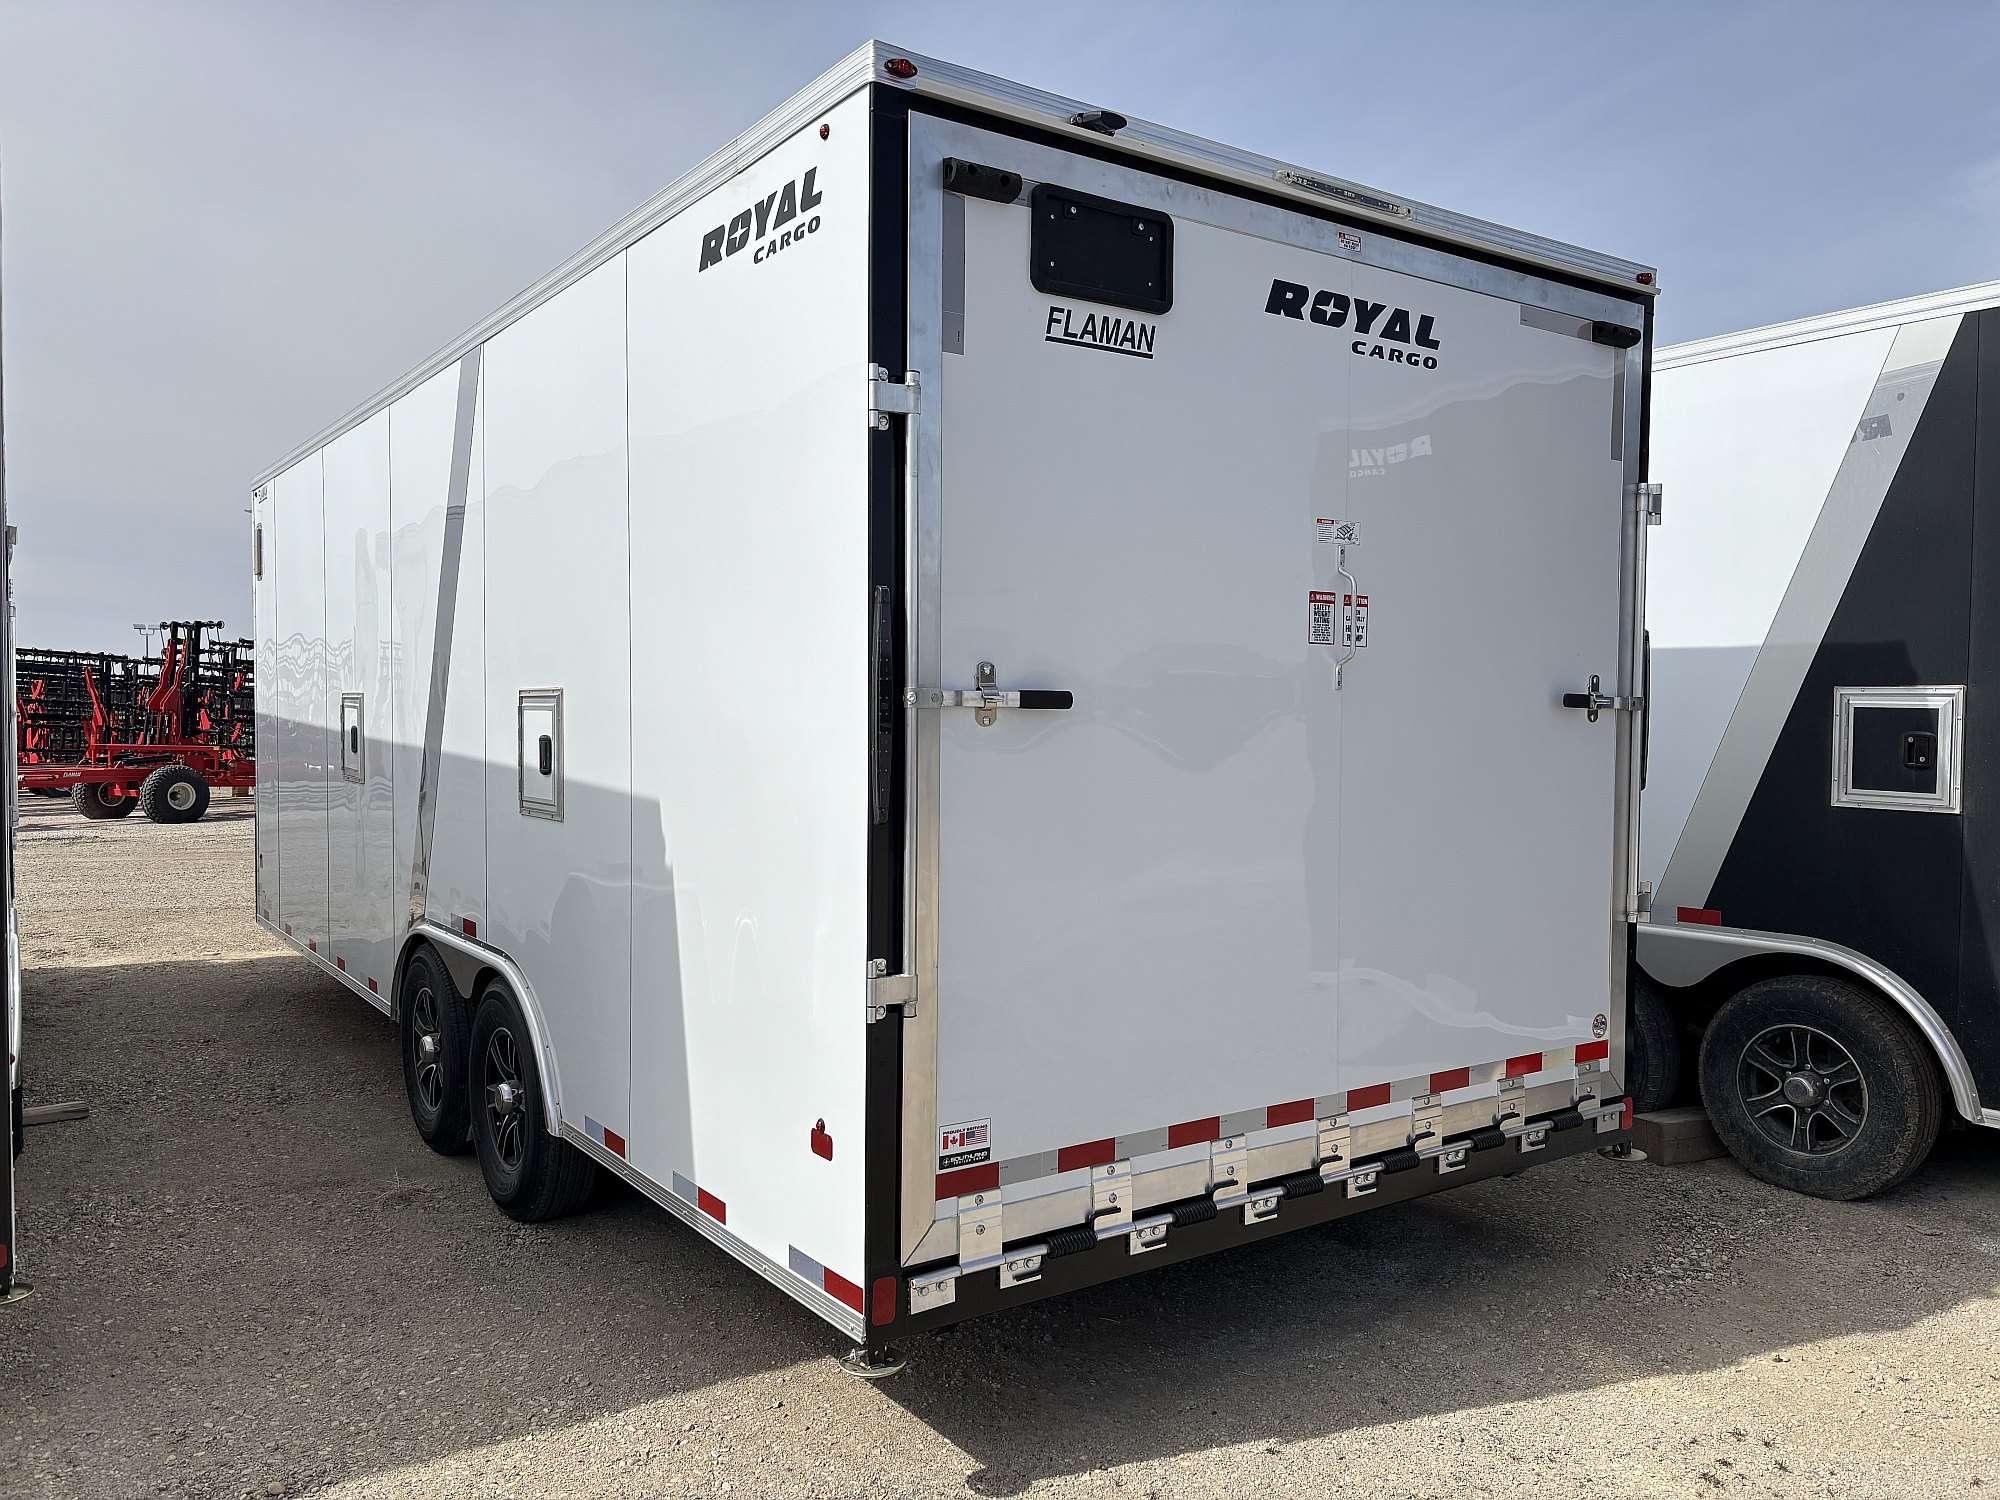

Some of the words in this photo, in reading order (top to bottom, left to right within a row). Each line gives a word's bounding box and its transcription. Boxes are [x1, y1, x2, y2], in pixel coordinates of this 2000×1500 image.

[698, 166, 823, 273] ROYAL
[753, 215, 821, 265] CARGO
[1045, 305, 1156, 353] FLAMAN
[1264, 278, 1441, 351] ROYAL
[1351, 340, 1438, 370] CARGO
[1313, 603, 1331, 611] SAFETY
